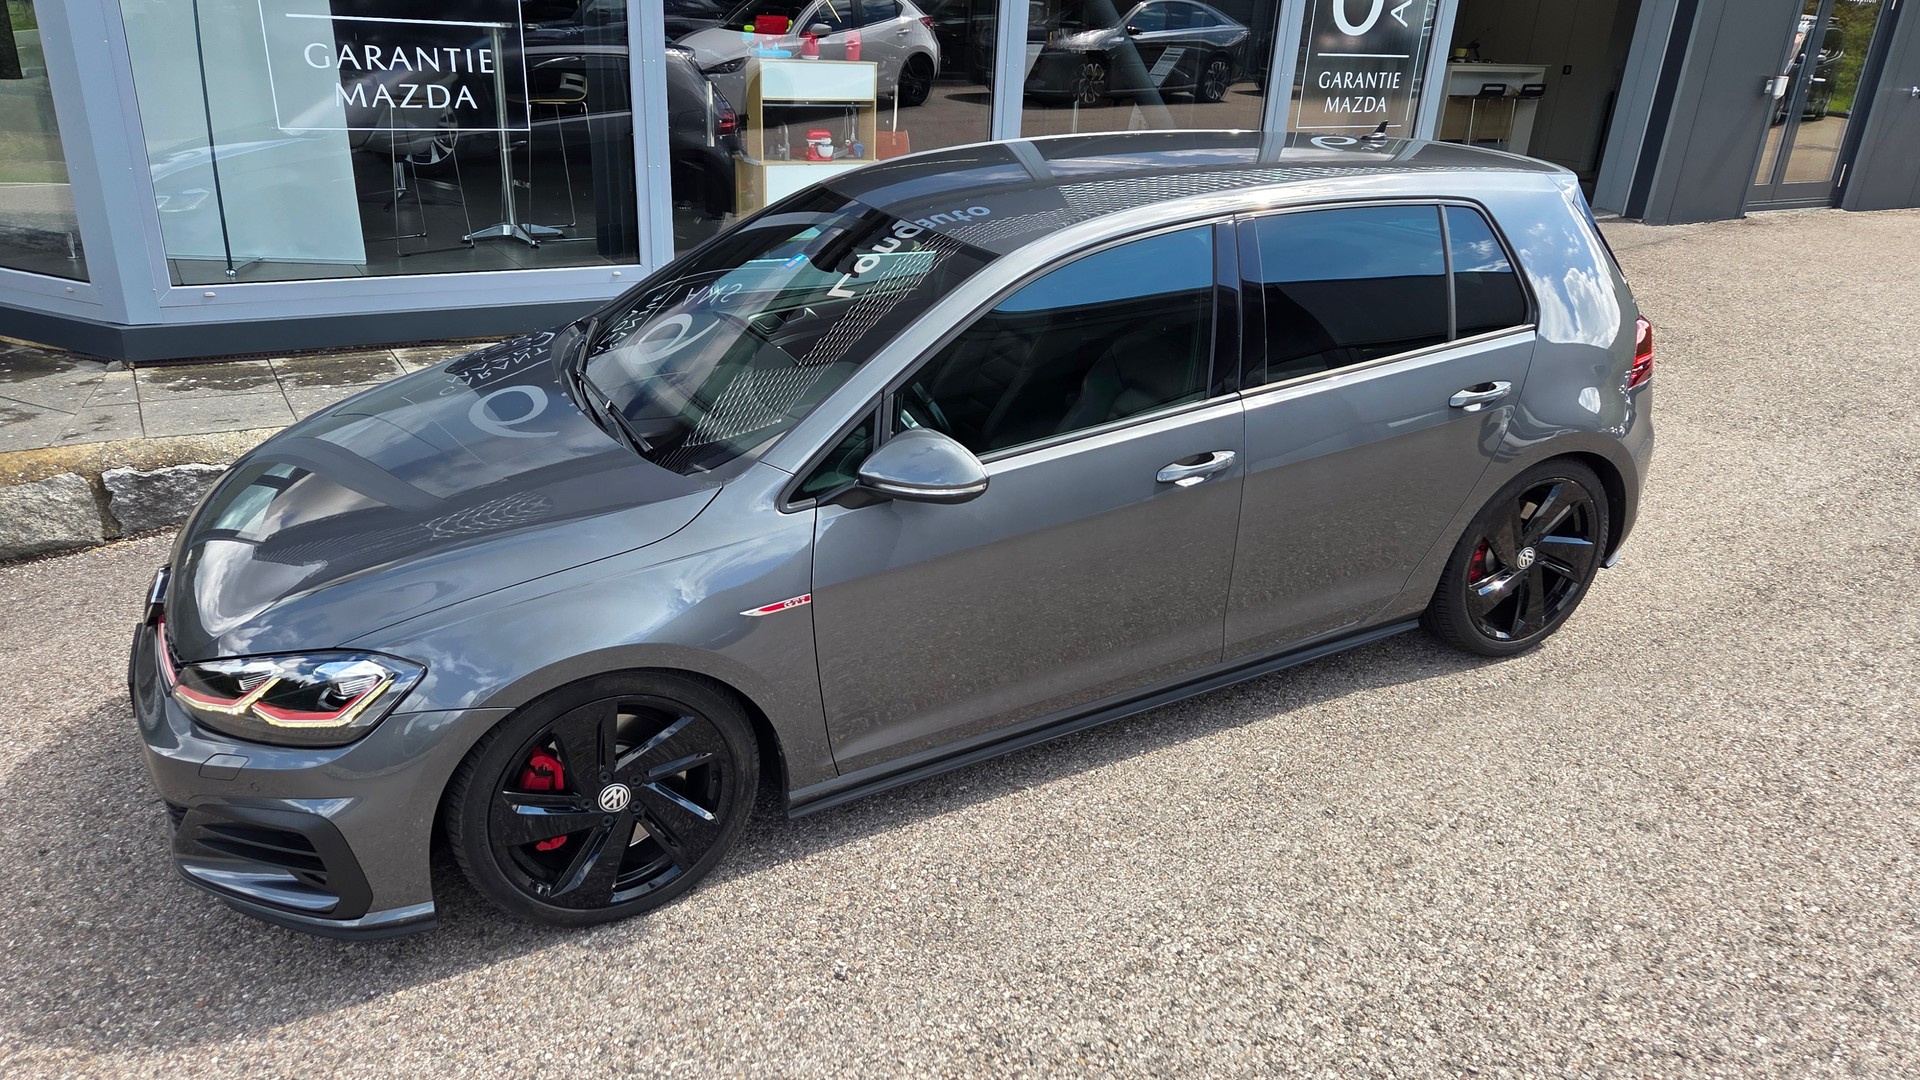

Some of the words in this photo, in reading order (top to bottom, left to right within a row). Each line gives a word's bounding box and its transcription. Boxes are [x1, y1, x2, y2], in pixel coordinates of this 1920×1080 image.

[303, 42, 495, 74] GARANTIE
[1318, 71, 1402, 89] GARANTIE
[334, 82, 479, 110] MAZDA
[1323, 96, 1387, 113] MAZDA
